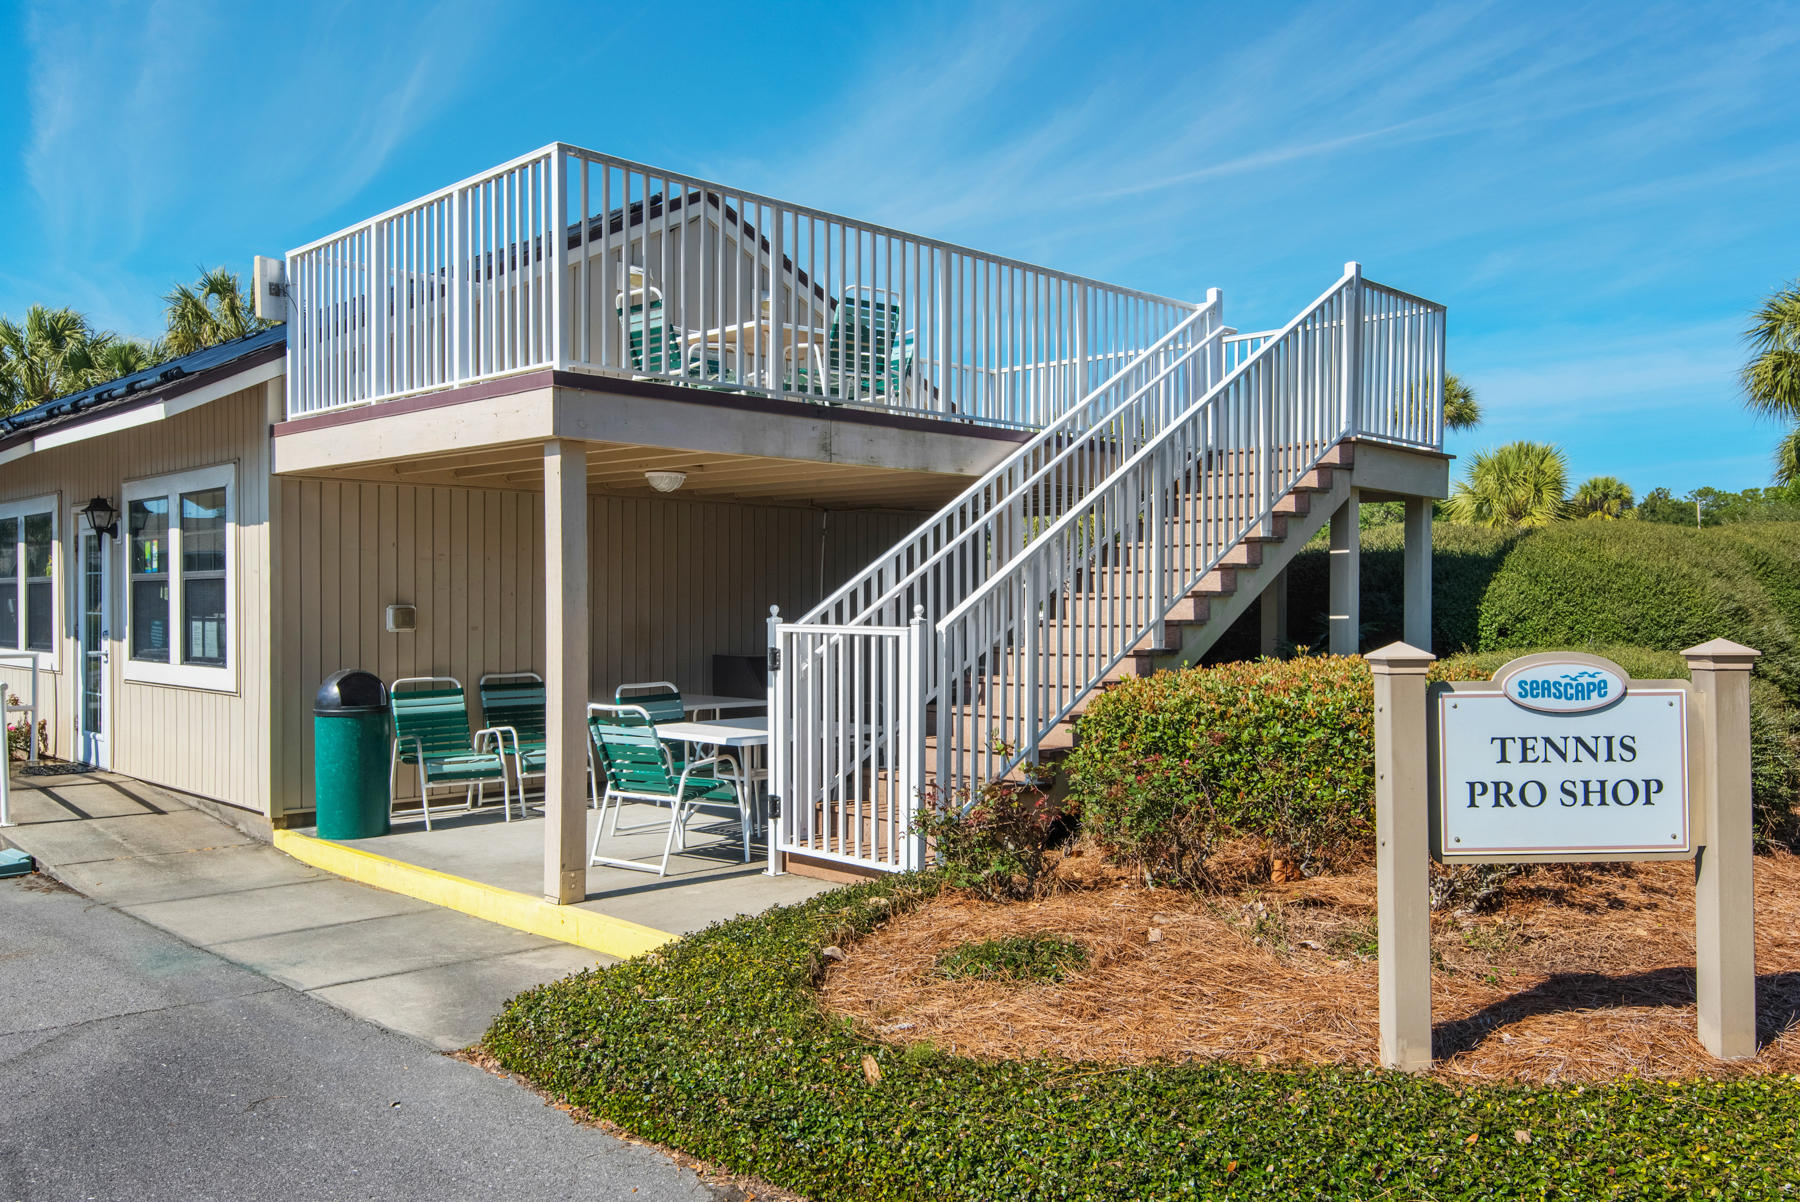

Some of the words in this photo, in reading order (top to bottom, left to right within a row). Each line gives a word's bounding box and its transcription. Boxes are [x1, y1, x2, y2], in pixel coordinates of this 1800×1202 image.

[1490, 735, 1637, 764] TENNIS
[1465, 780, 1547, 809] PRO
[1559, 778, 1664, 808] SHOP
